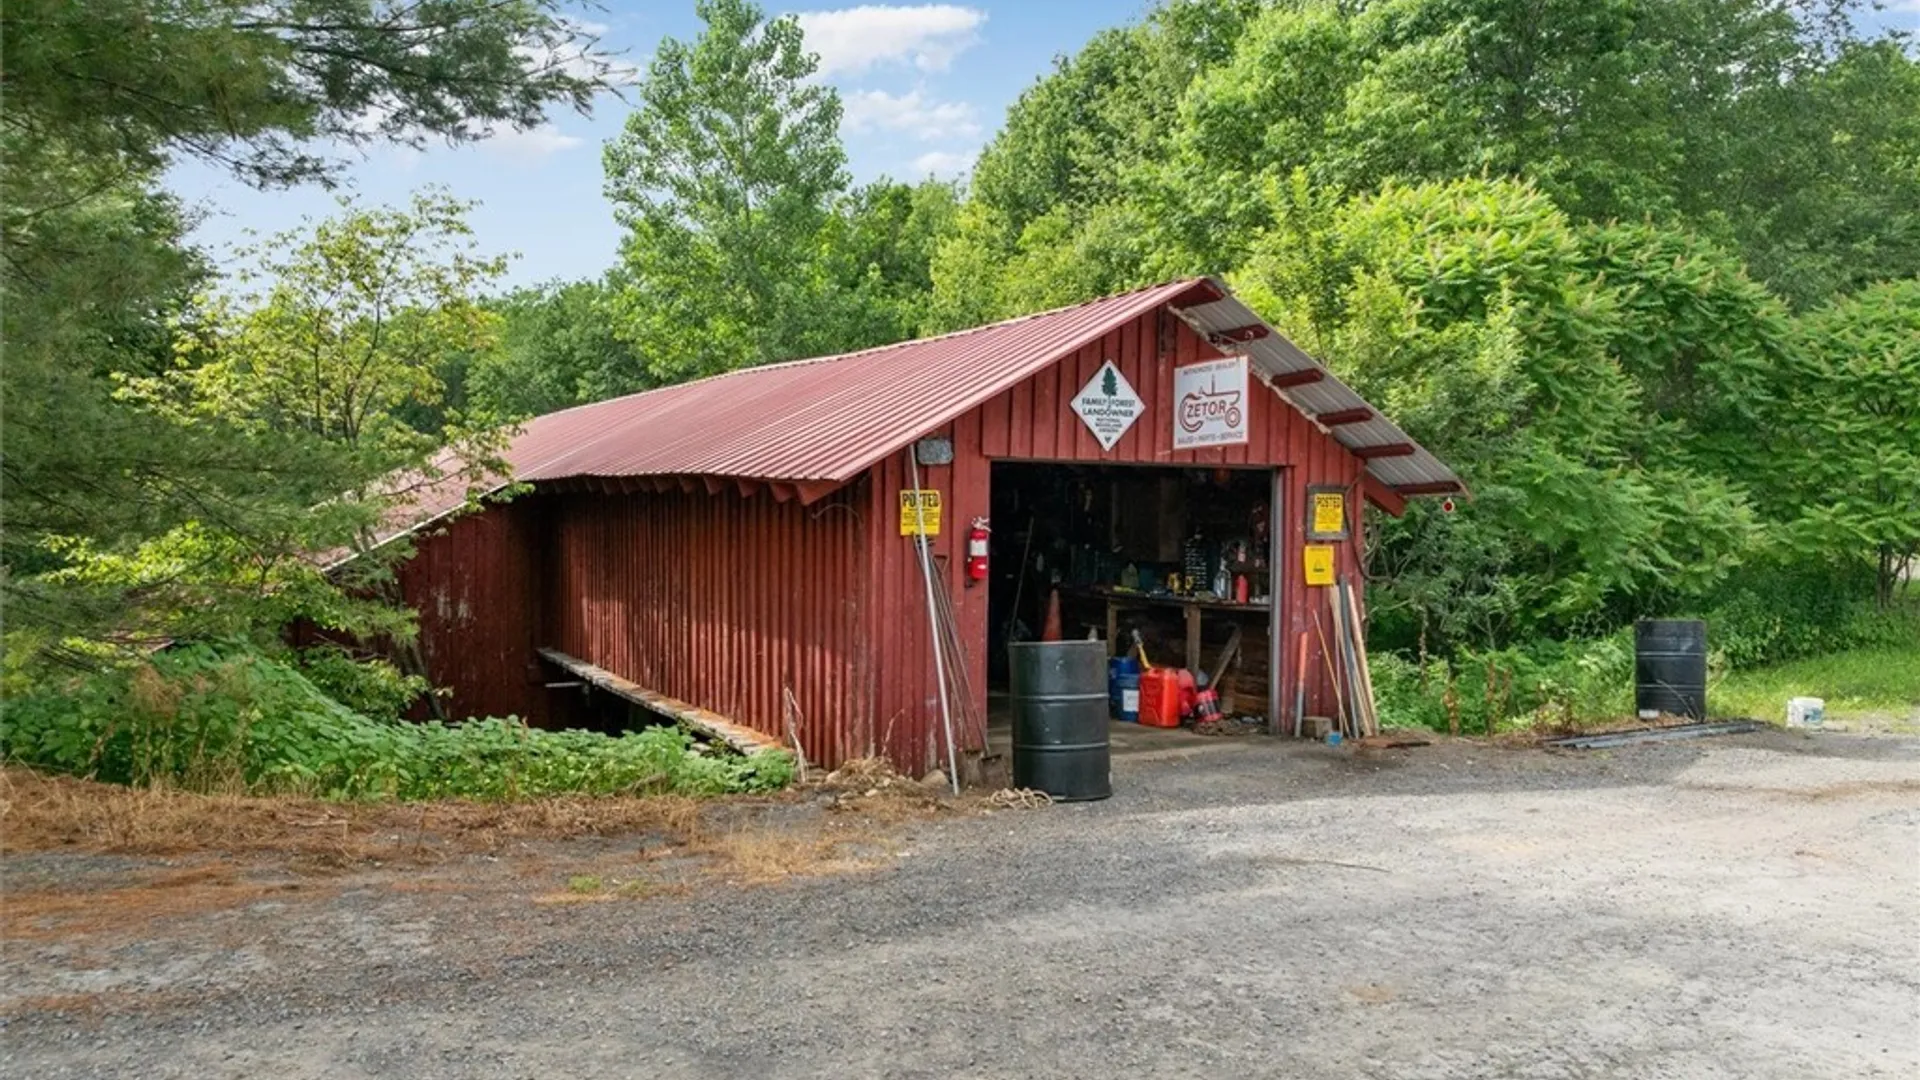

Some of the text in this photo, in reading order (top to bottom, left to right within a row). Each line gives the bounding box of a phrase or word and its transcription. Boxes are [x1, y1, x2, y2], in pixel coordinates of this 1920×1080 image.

[1082, 397, 1135, 407] FAMILY FOREST
[1082, 408, 1134, 417] LANDOWNER
[1187, 400, 1226, 418] ZETOR
[903, 493, 939, 507] POTED
